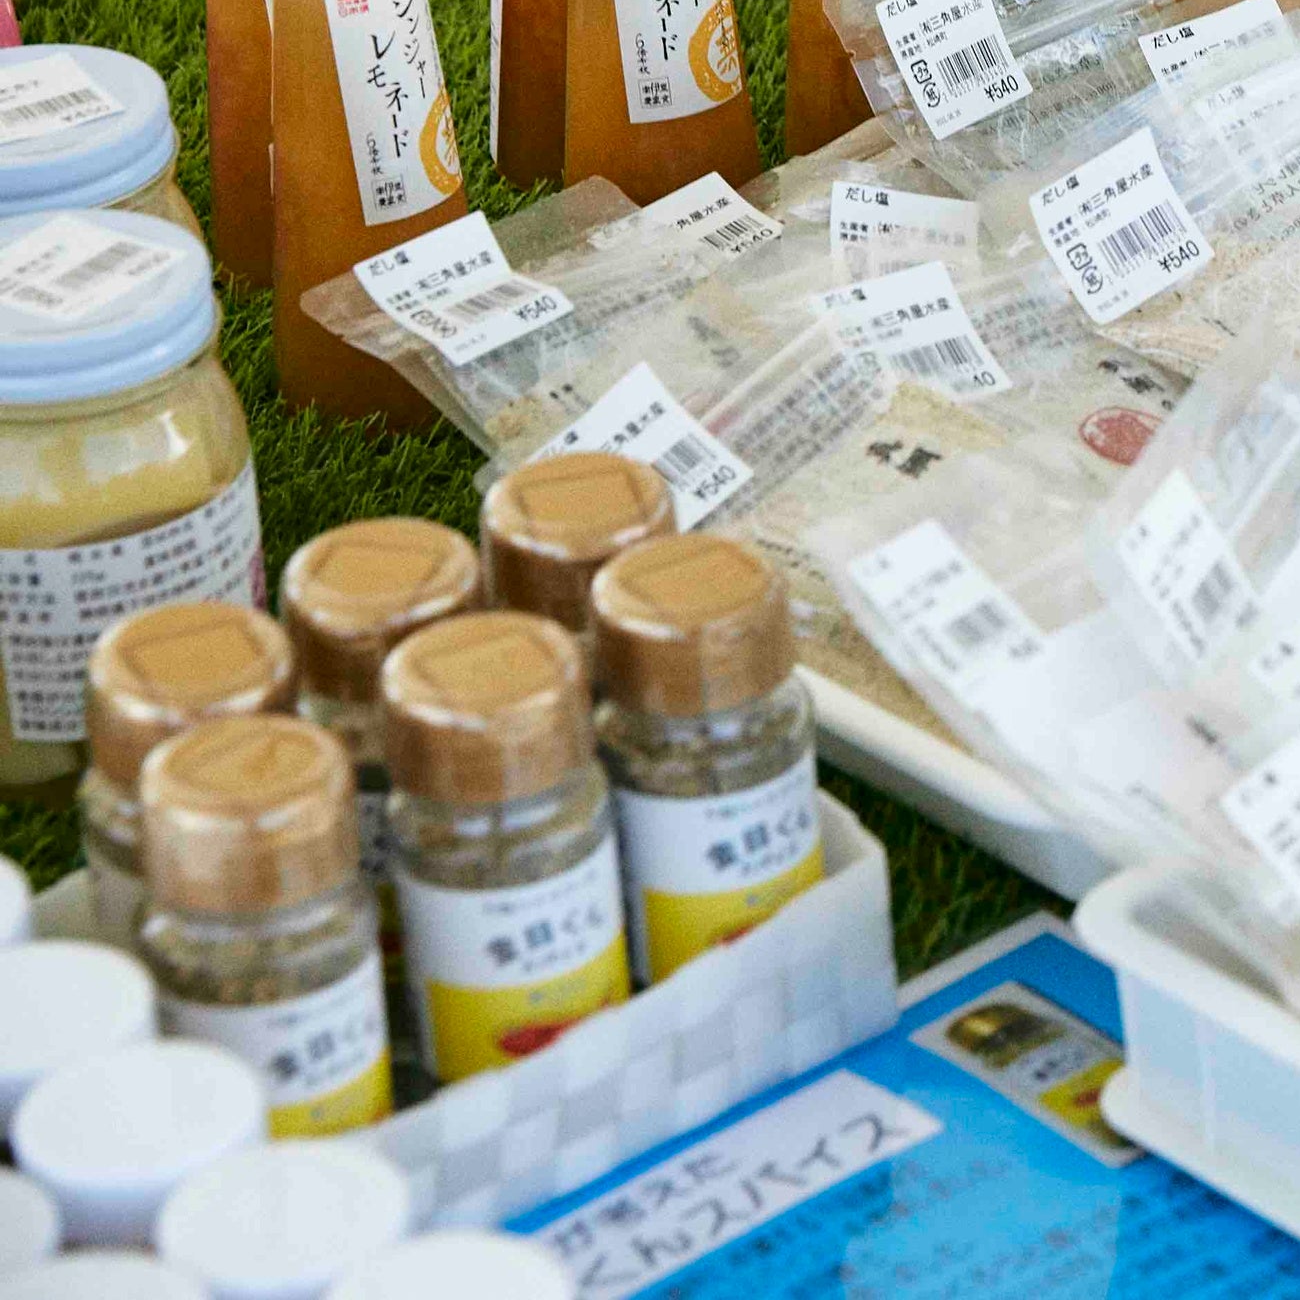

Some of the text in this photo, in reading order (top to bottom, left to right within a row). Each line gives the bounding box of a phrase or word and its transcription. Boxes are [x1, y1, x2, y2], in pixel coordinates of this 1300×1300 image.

[1152, 25, 1195, 49] だし塩
[367, 30, 408, 159] レモネード
[984, 75, 1019, 103] ¥540
[846, 187, 889, 206] だし塩
[1041, 174, 1080, 206] だし塩
[367, 250, 409, 278] だし塩
[1158, 239, 1200, 273] ¥540
[518, 295, 559, 322] ¥540
[694, 464, 738, 502] ¥540
